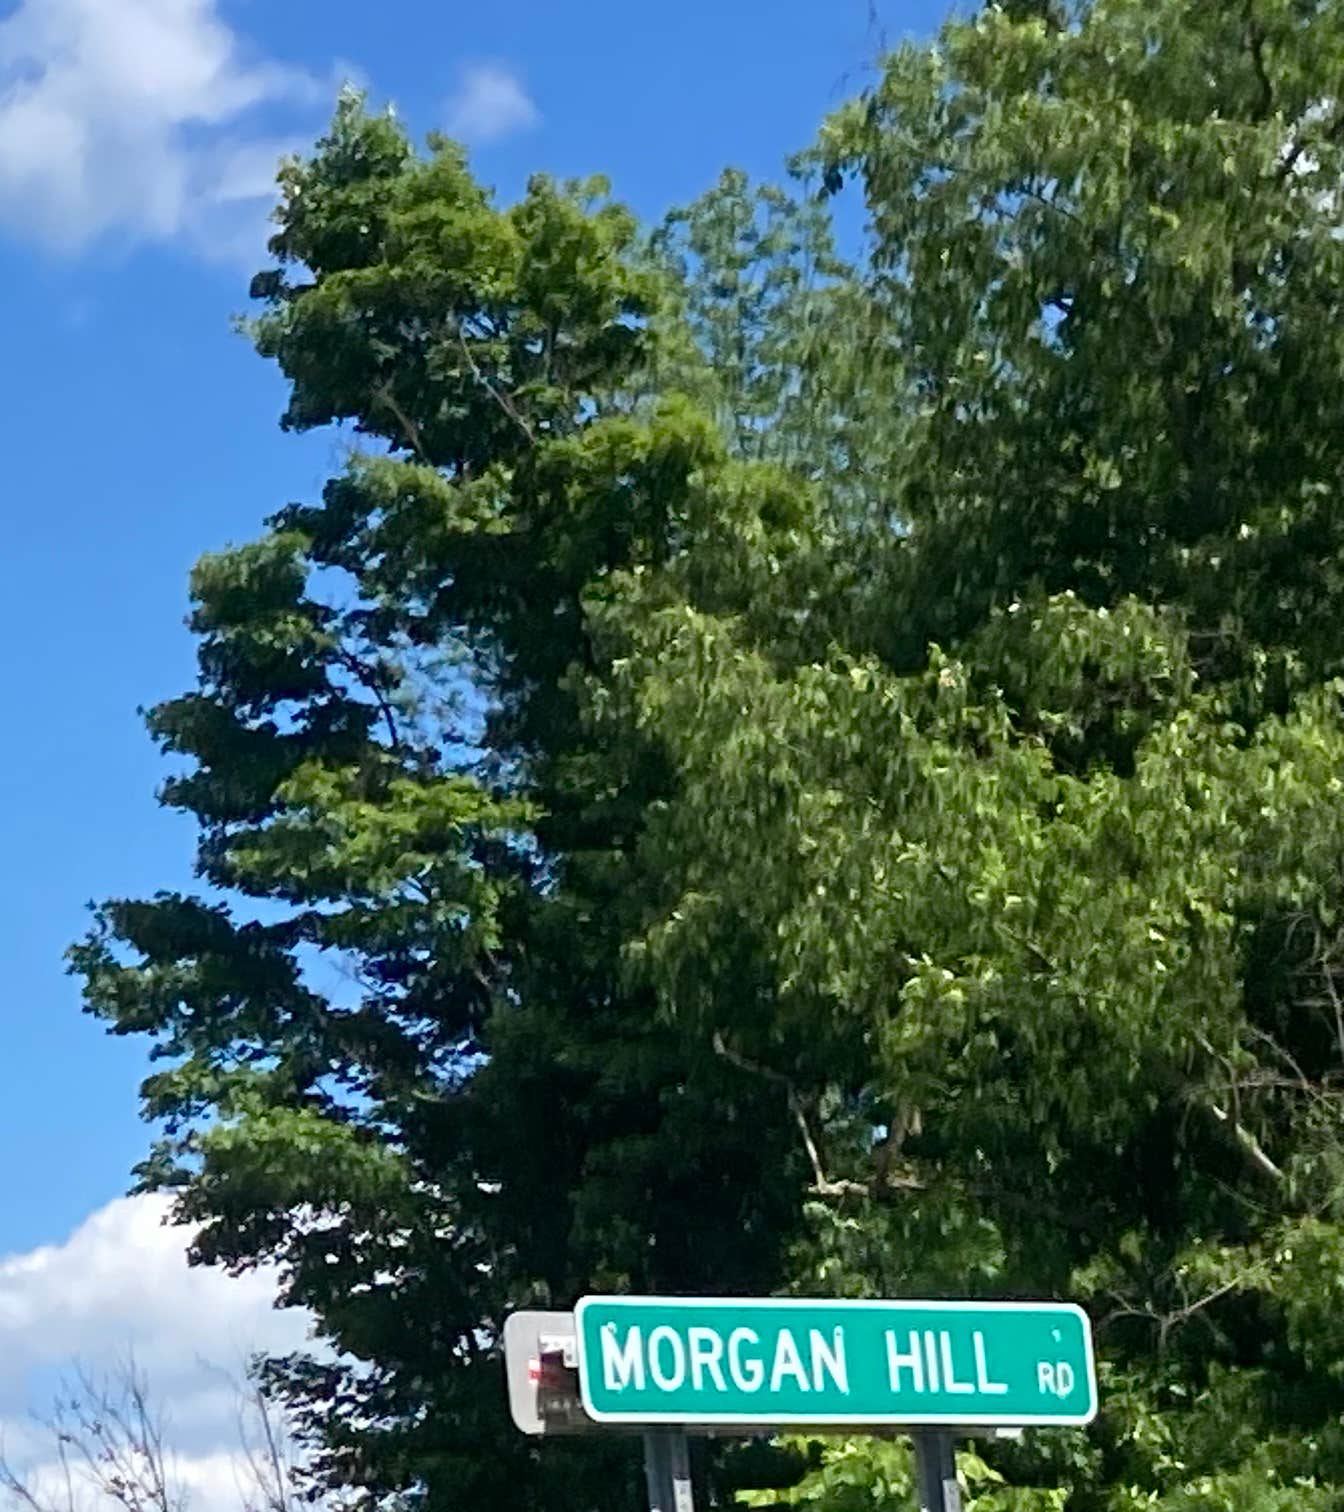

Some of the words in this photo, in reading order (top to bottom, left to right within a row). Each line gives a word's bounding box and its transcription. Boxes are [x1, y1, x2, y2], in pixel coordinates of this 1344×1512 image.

[601, 1322, 849, 1396] MORGAN
[886, 1329, 1008, 1395] HILL
[1038, 1361, 1075, 1397] RD
